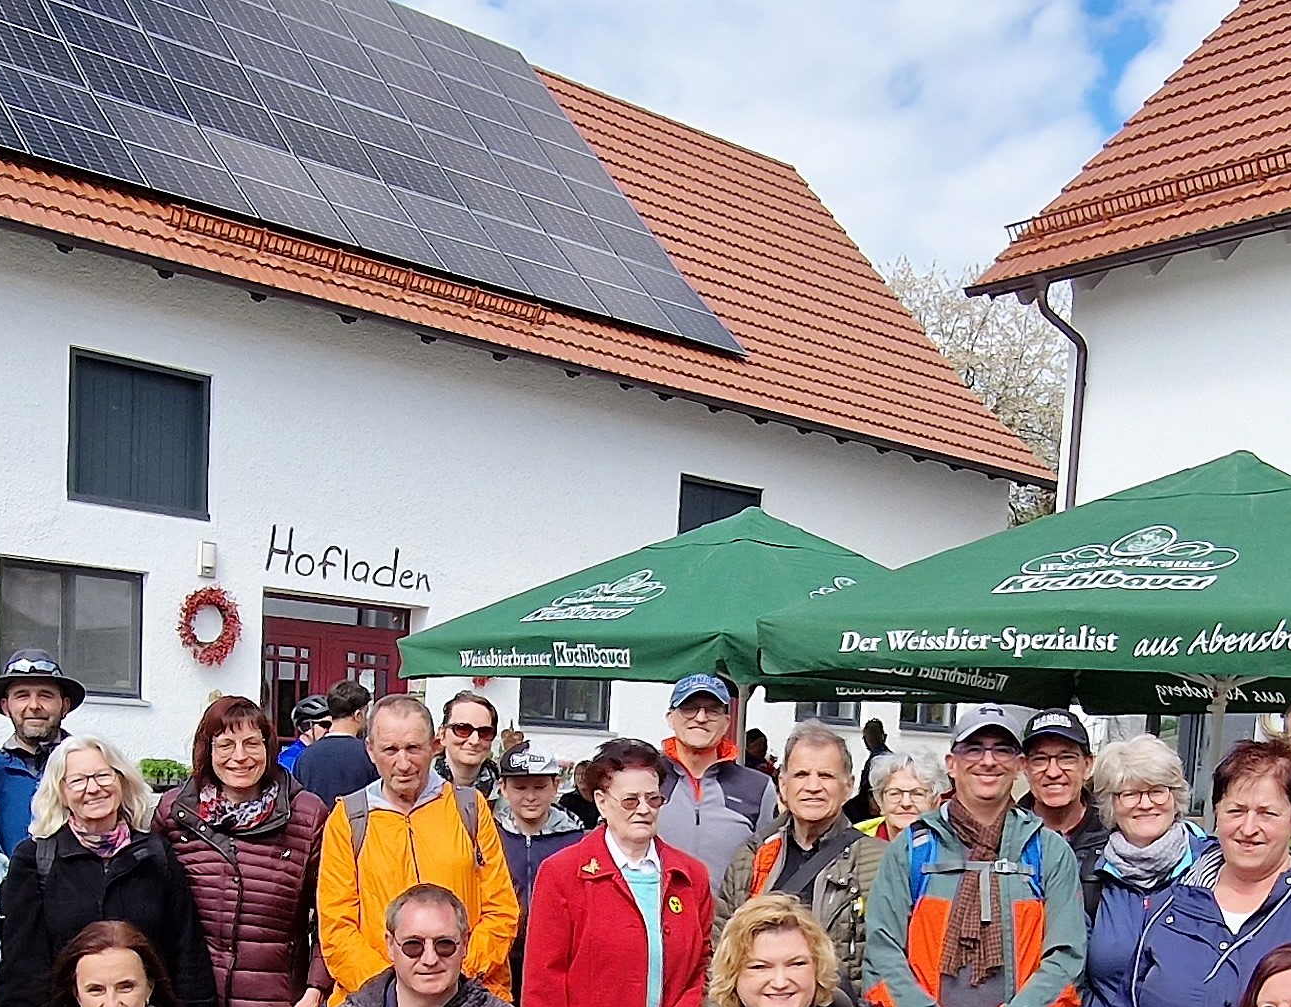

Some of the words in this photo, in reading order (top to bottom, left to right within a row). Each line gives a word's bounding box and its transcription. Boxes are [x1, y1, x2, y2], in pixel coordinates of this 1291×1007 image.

[265, 524, 431, 593] Hofladen
[991, 571, 1219, 594] Kuchlbauer
[459, 646, 552, 667] Weissbierbrauer
[552, 641, 631, 668] Kuchlbauer
[838, 630, 882, 653] Der
[886, 624, 1120, 659] Weissbier-Spezialist
[1133, 633, 1183, 658] aus
